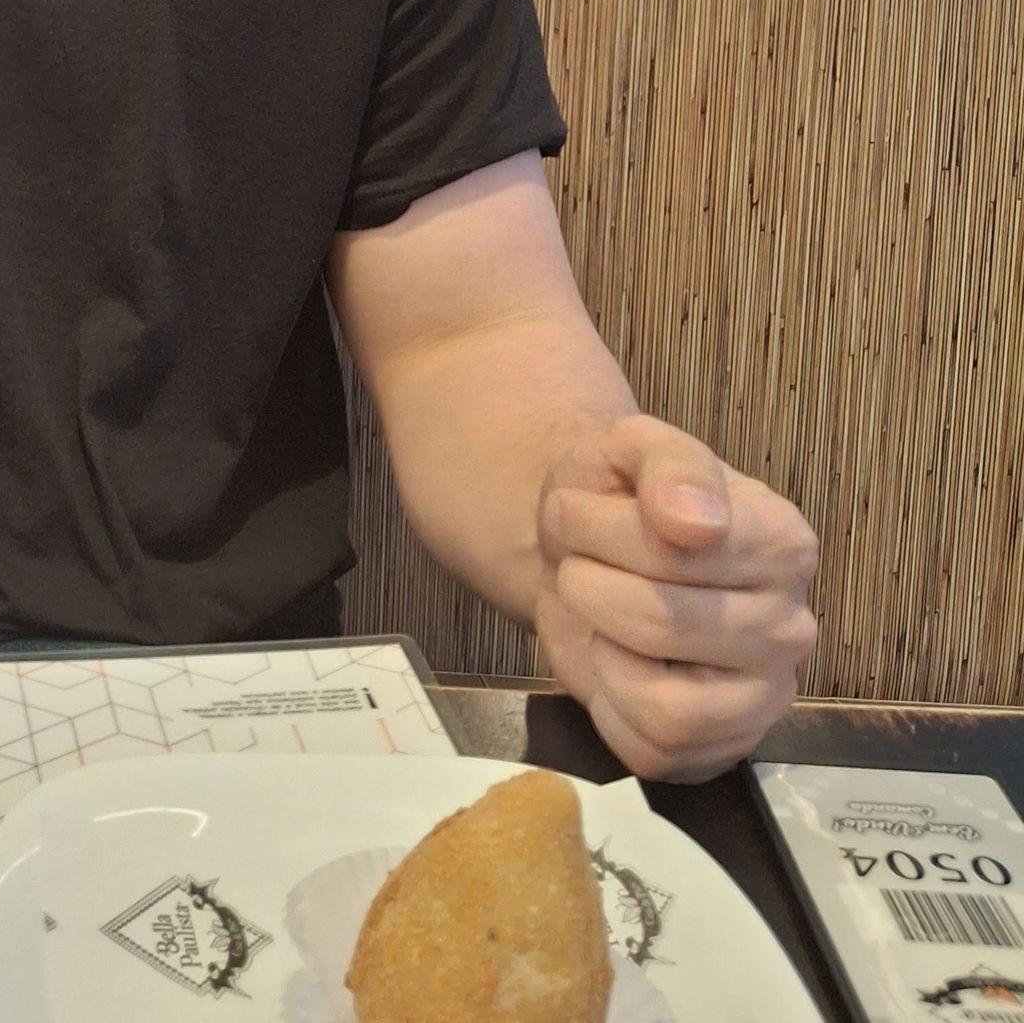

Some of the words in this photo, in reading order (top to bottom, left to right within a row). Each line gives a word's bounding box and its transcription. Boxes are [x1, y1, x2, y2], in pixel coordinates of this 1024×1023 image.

[839, 847, 1012, 886] 0504
[152, 913, 180, 957] Bella
[175, 903, 202, 969] Paulista
